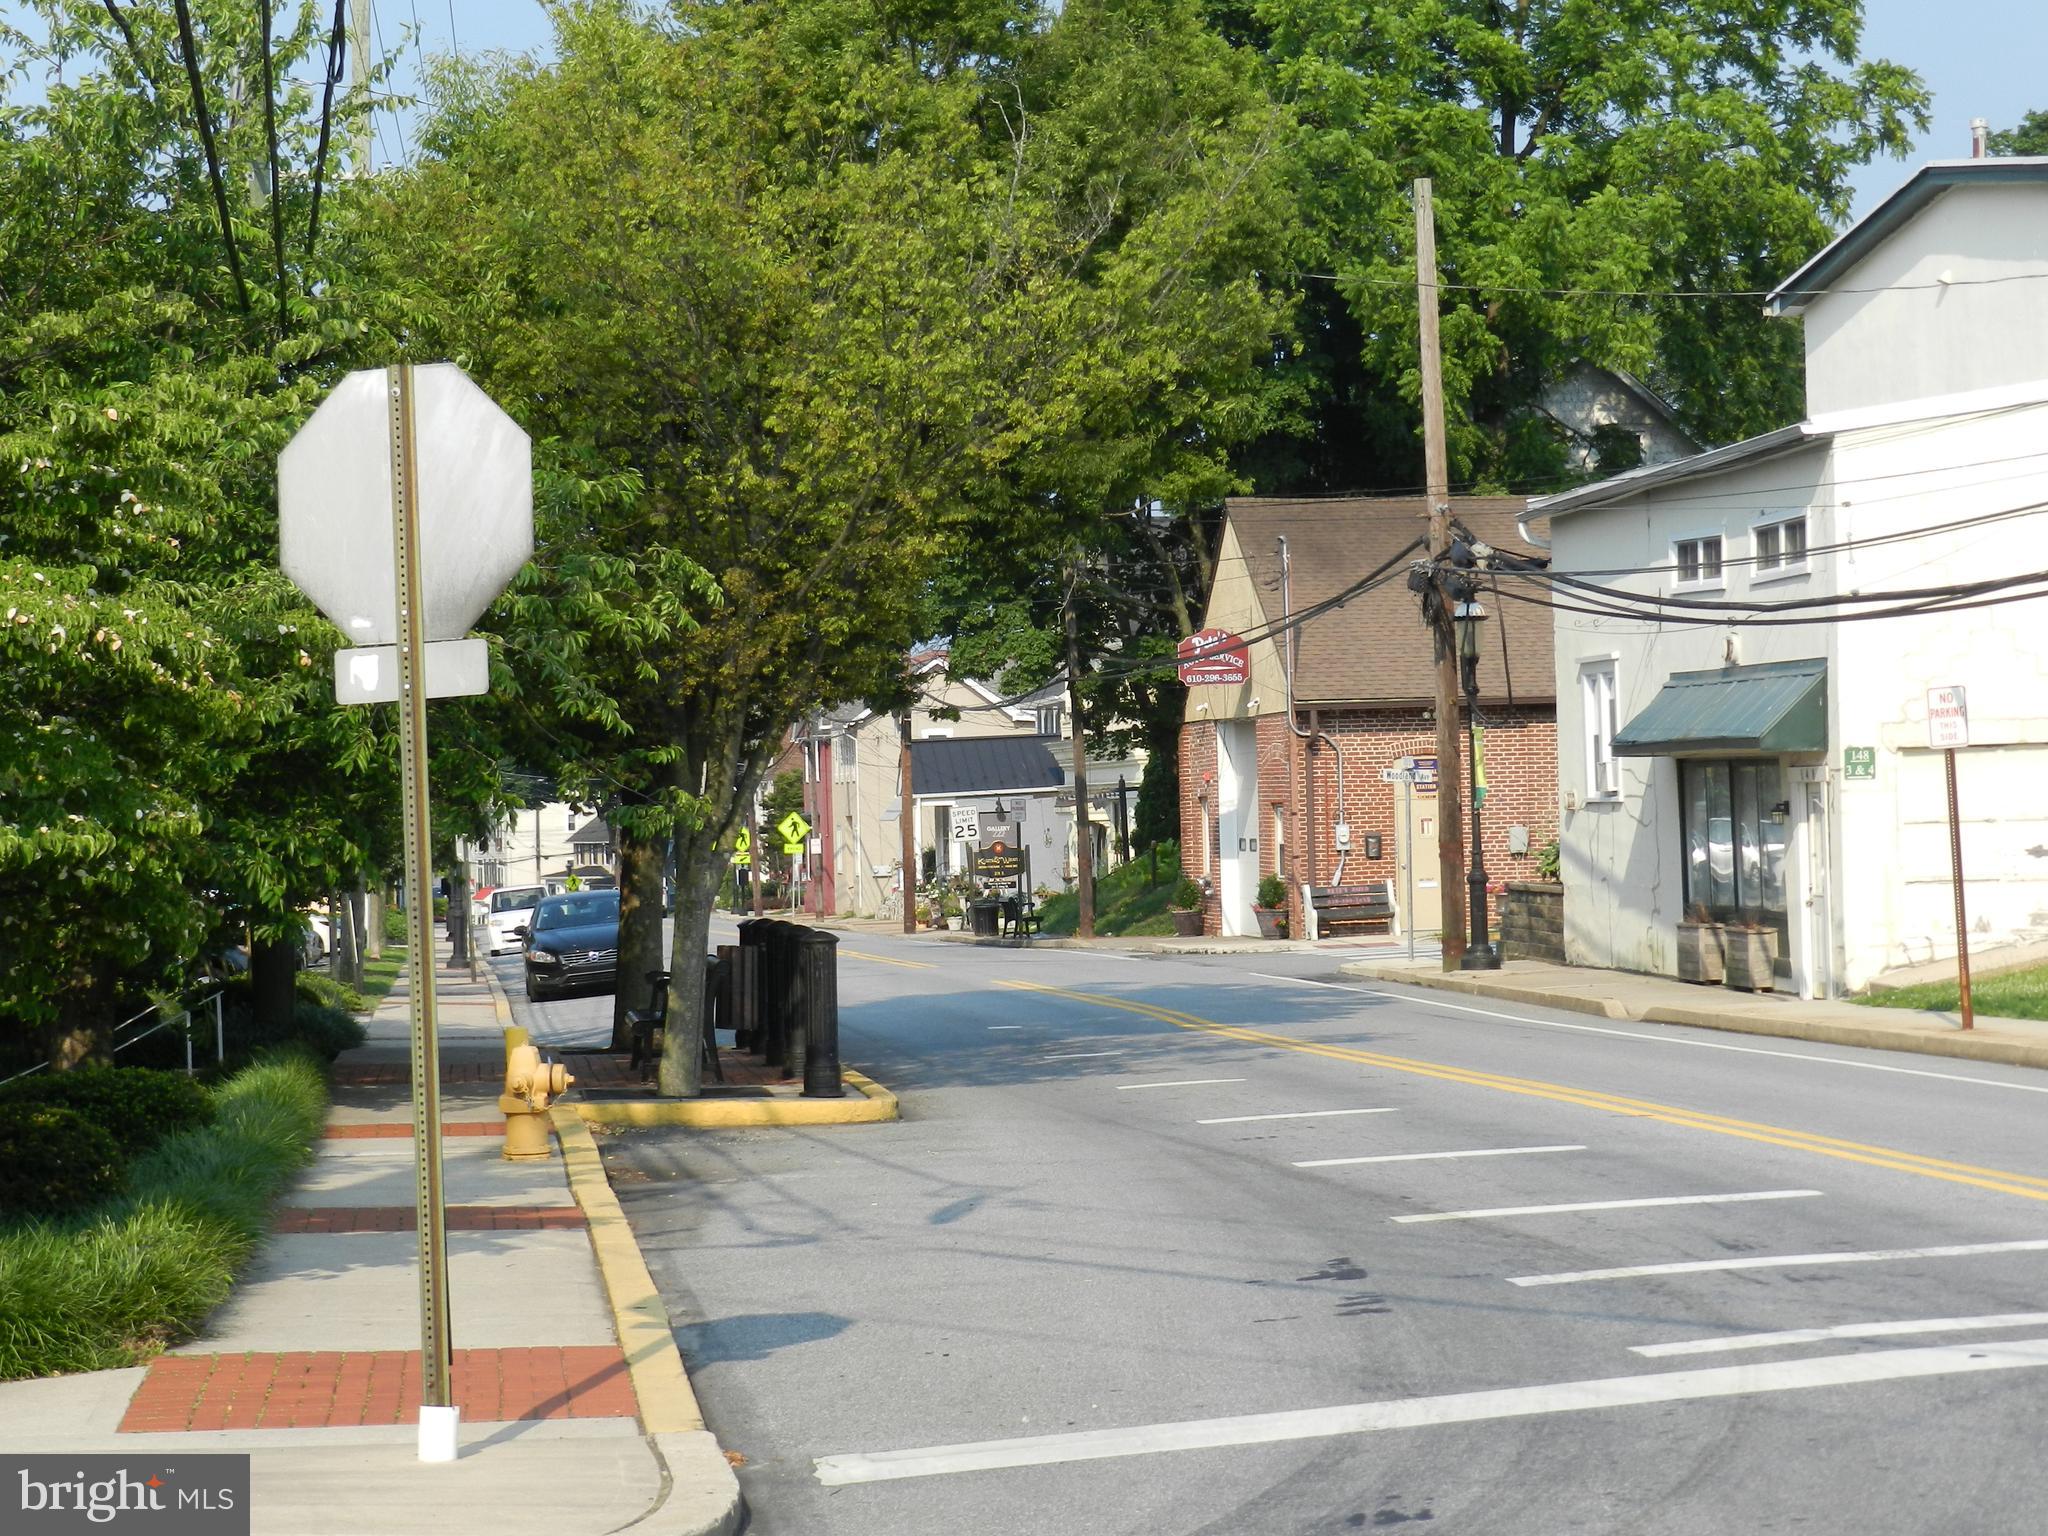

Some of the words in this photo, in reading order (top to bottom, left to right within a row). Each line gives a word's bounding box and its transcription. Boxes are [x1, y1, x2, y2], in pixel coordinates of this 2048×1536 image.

[1939, 692, 1953, 704] NO
[1930, 705, 1965, 720] PARKING
[1852, 750, 1870, 760] 148
[1386, 770, 1416, 780] Woodland
[1846, 765, 1852, 775] 3
[1855, 765, 1865, 775] &
[1868, 764, 1874, 775] 4
[952, 809, 976, 818] SPEED
[955, 824, 977, 839] 25
